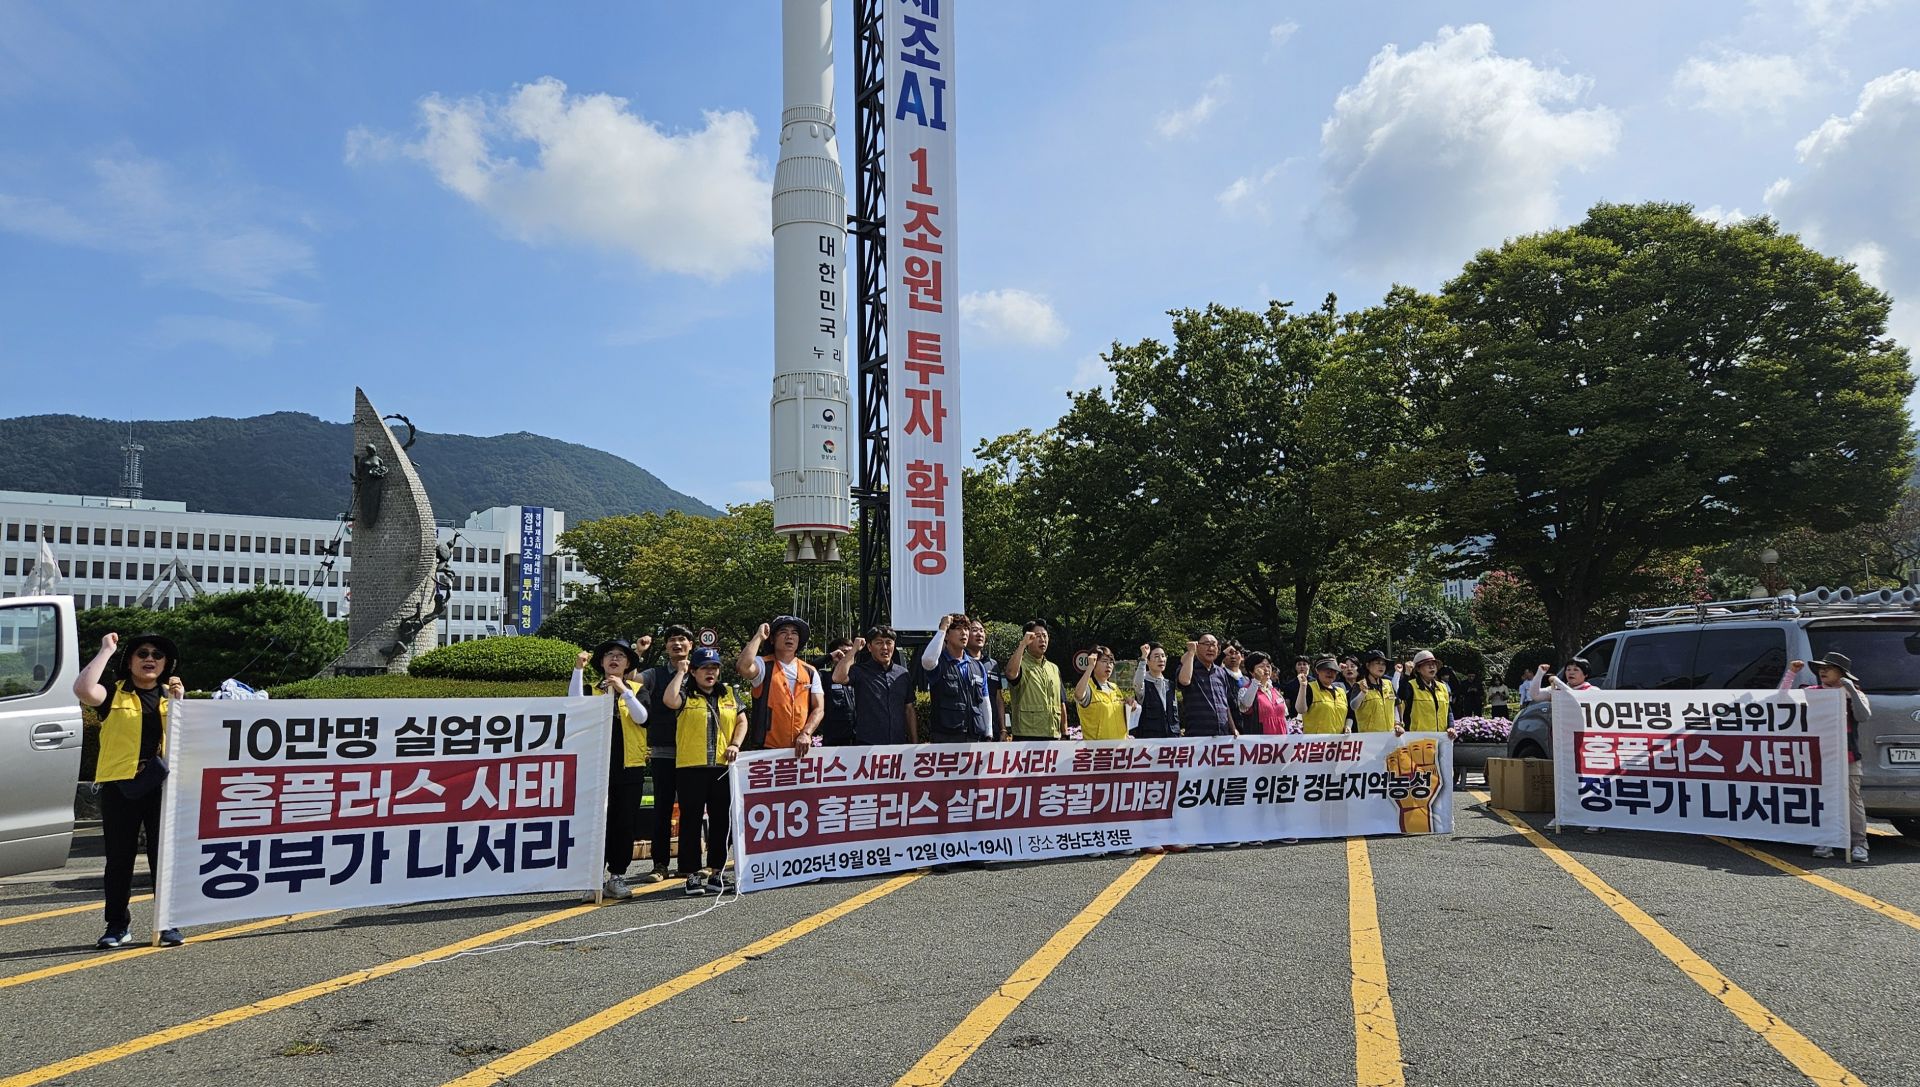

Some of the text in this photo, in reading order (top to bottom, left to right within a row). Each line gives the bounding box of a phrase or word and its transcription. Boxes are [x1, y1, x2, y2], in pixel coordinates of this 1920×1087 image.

[902, 147, 943, 313] 1조원
[819, 235, 836, 339] 대한민국
[903, 330, 947, 443] 투자
[523, 512, 534, 536] 정부
[904, 459, 949, 576] 확정
[522, 578, 532, 602] 투자
[521, 604, 531, 629] 확정
[703, 634, 713, 643] 30
[1078, 656, 1089, 667] 30
[222, 713, 567, 761] 10만명 실업위기
[1580, 702, 1809, 733] 10만명 실업위기
[747, 740, 1364, 790] 홈플러스 사태, 정부가 나서라! 홈플러스 먹튀 시도 MBK 처벌하라!
[1582, 735, 1813, 778] 홈플러스 사태
[216, 761, 565, 829] 홈플러스 사태
[747, 771, 1432, 842] 9.13 홈플러스 살리기 총궐기대회 성사를 위한 경남지역농성
[1577, 776, 1691, 818] 정부가
[1701, 782, 1825, 827] 나서라
[199, 819, 575, 899] 정부가 나서라
[750, 859, 779, 883] 일시
[781, 855, 837, 877] 2025년
[838, 849, 865, 870] 9월
[866, 846, 892, 867] 8일
[906, 842, 939, 861] 12일
[940, 836, 1013, 861] (9시~19시)
[1027, 834, 1054, 853] 장소
[1056, 829, 1106, 851] 경남도청
[1106, 828, 1133, 846] 정문
